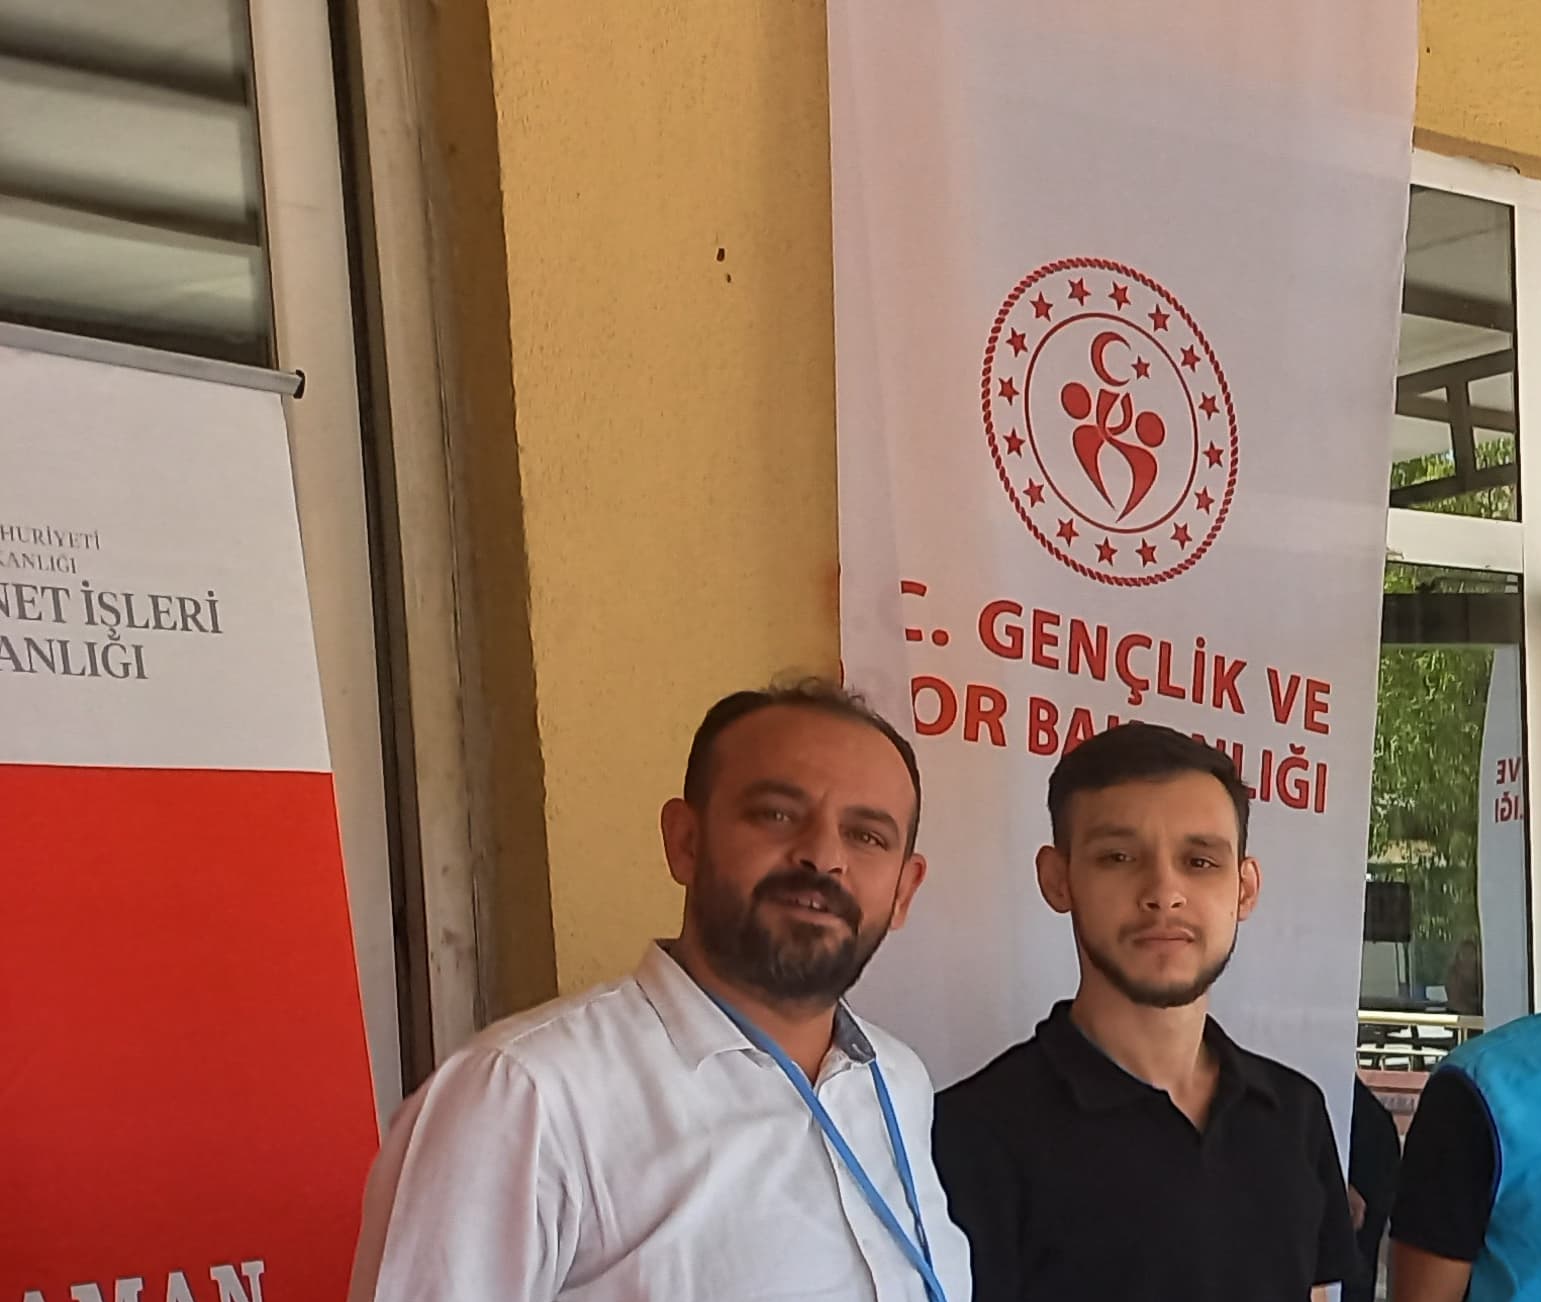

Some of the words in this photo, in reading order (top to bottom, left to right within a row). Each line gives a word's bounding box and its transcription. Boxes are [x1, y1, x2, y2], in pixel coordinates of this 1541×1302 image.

[80, 580, 224, 641] İŞLERİ
[978, 600, 1247, 715] GENÇLİK
[1267, 667, 1331, 735] VE
